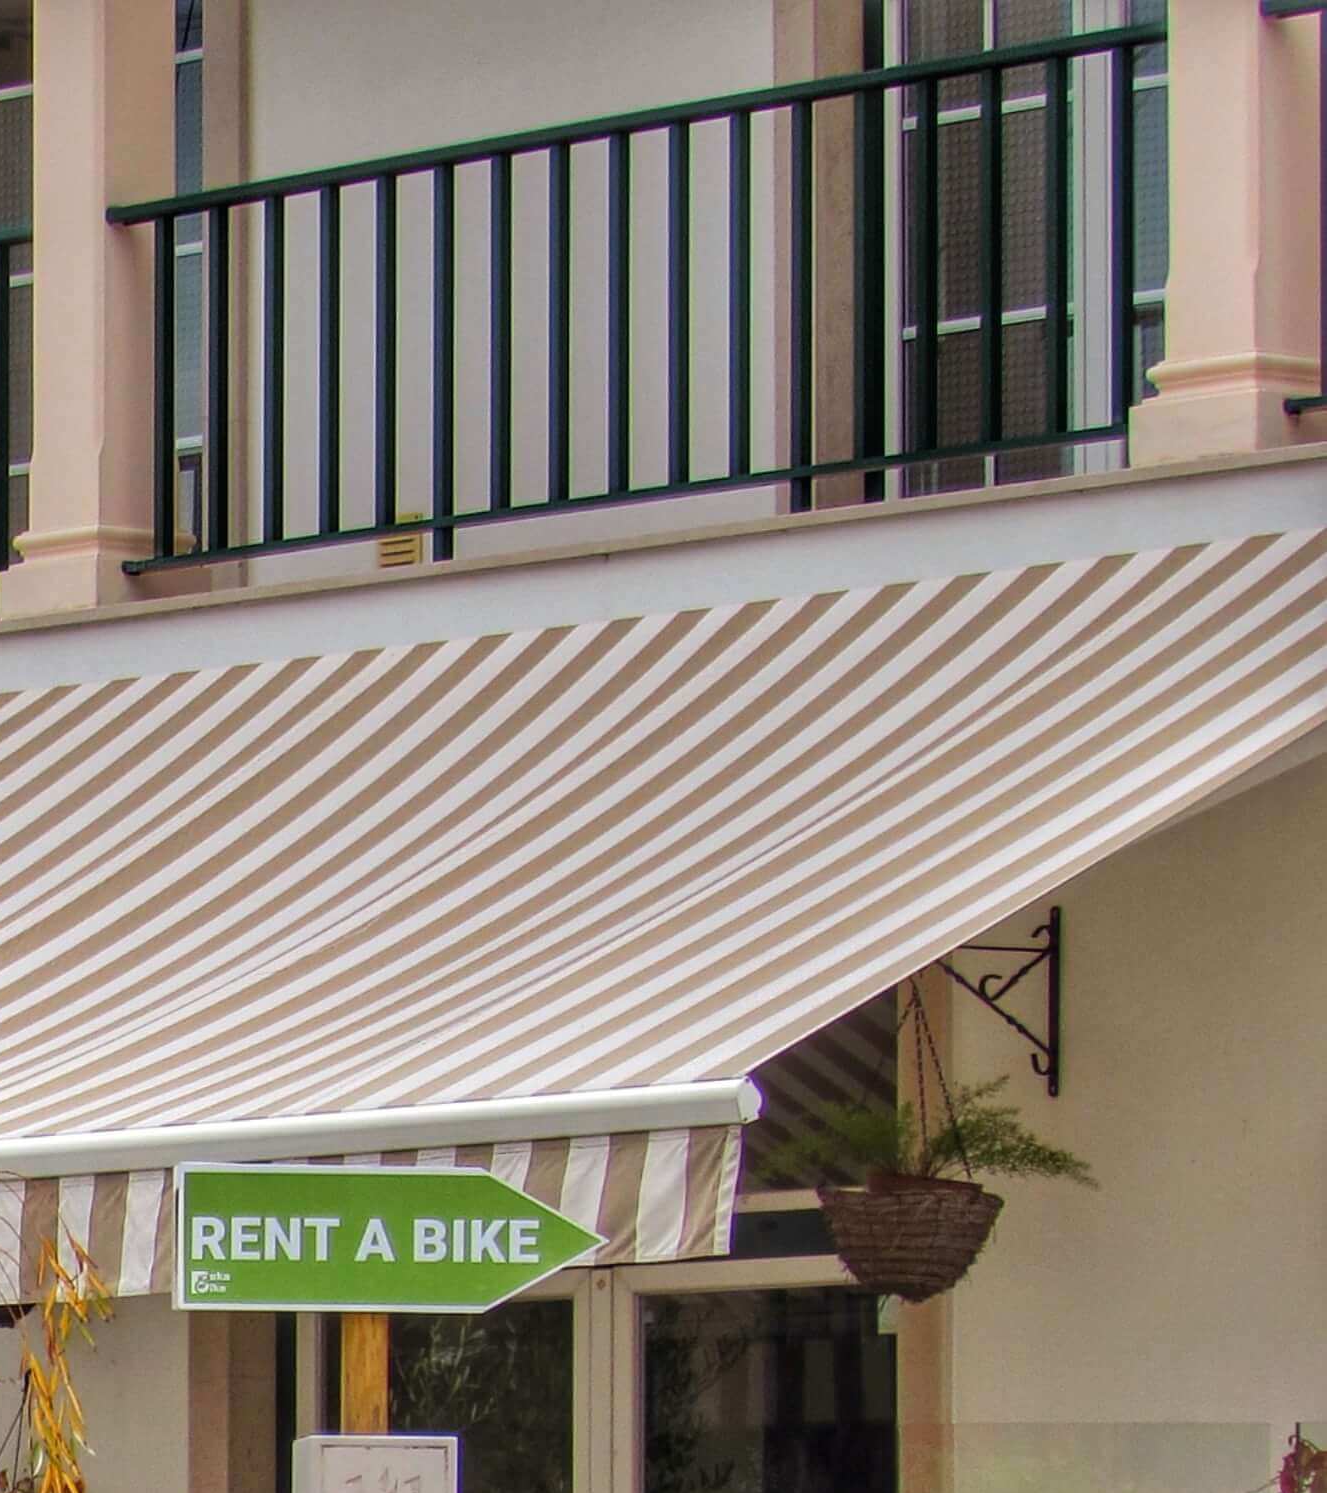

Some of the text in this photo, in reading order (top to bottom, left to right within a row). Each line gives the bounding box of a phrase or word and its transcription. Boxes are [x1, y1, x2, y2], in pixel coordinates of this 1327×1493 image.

[190, 1217, 541, 1263] RENT A BIKE
